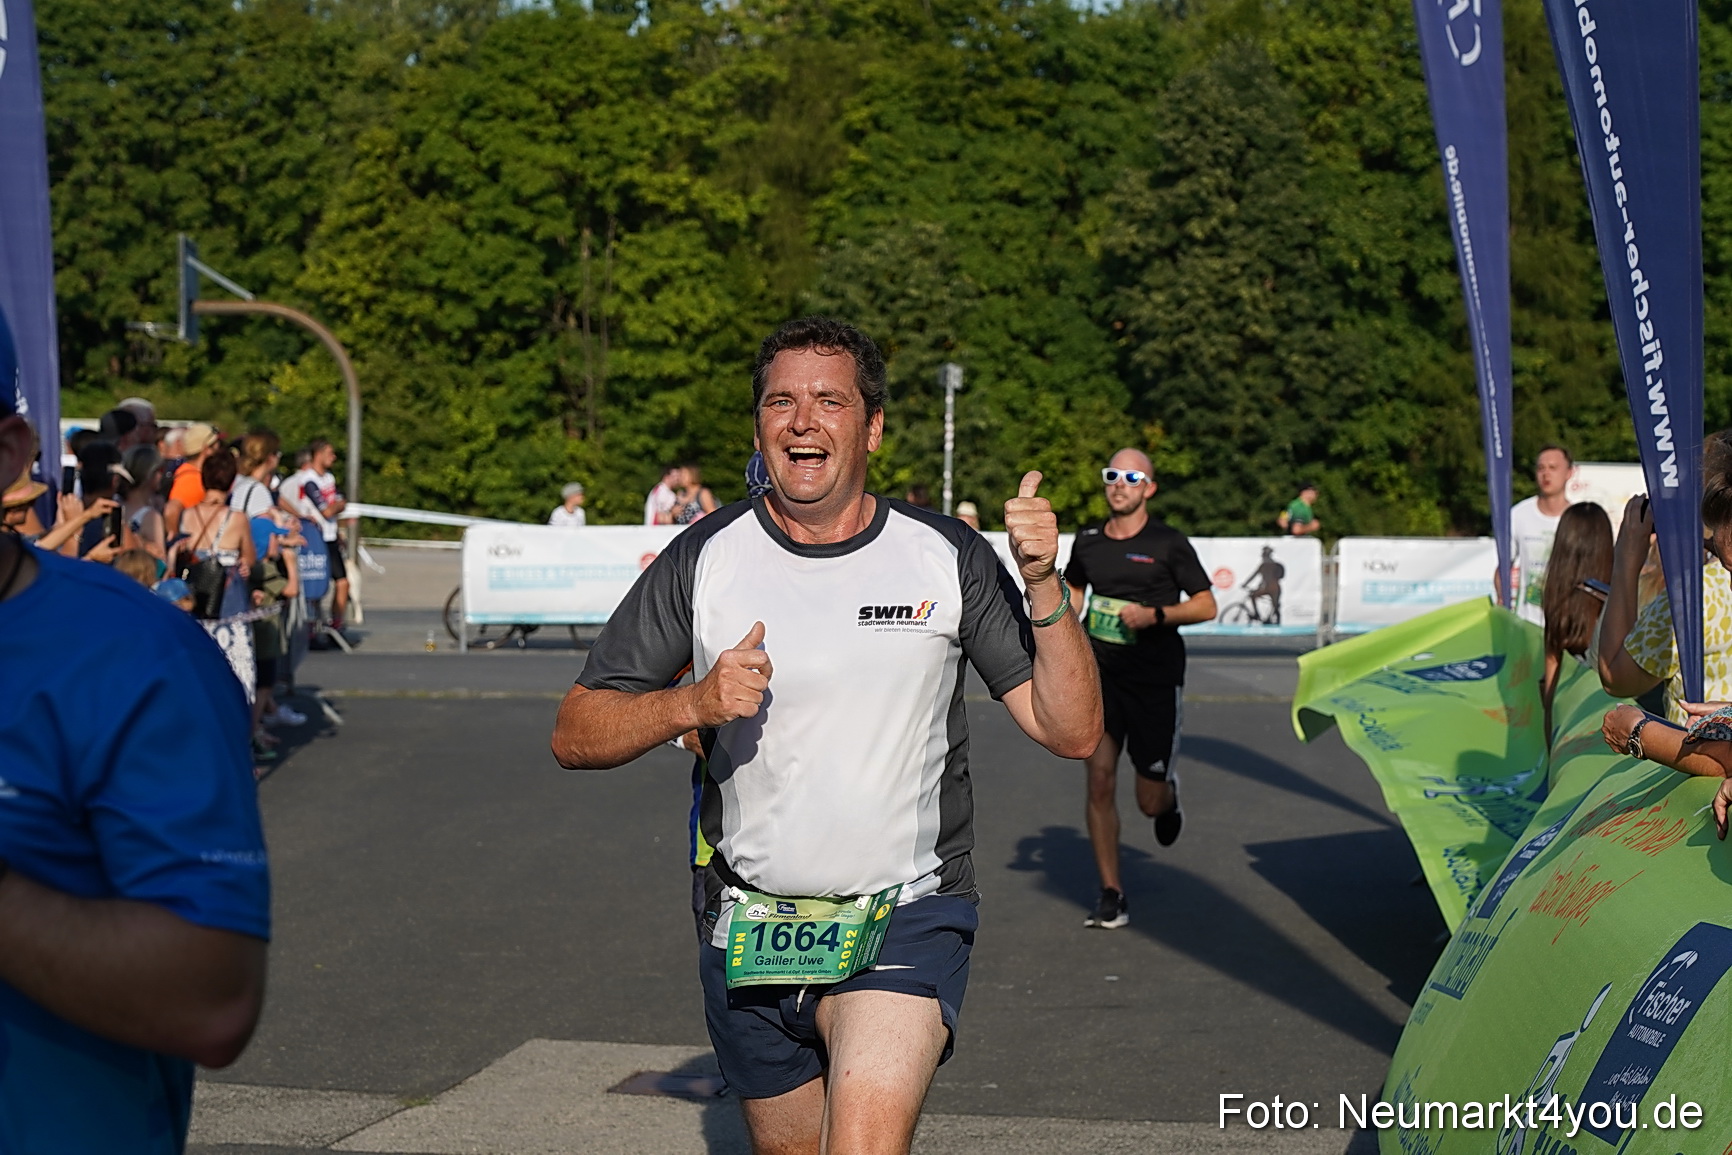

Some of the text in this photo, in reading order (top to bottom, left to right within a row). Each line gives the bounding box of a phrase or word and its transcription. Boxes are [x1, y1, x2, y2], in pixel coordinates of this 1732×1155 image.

[858, 605, 914, 620] swn
[732, 932, 747, 967] RUN
[750, 922, 841, 952] 1664
[838, 929, 858, 970] 2022
[754, 955, 824, 966] Gailler Uwe
[1637, 980, 1692, 1026] Fischer
[1627, 1023, 1666, 1048] AUTOMOBILE
